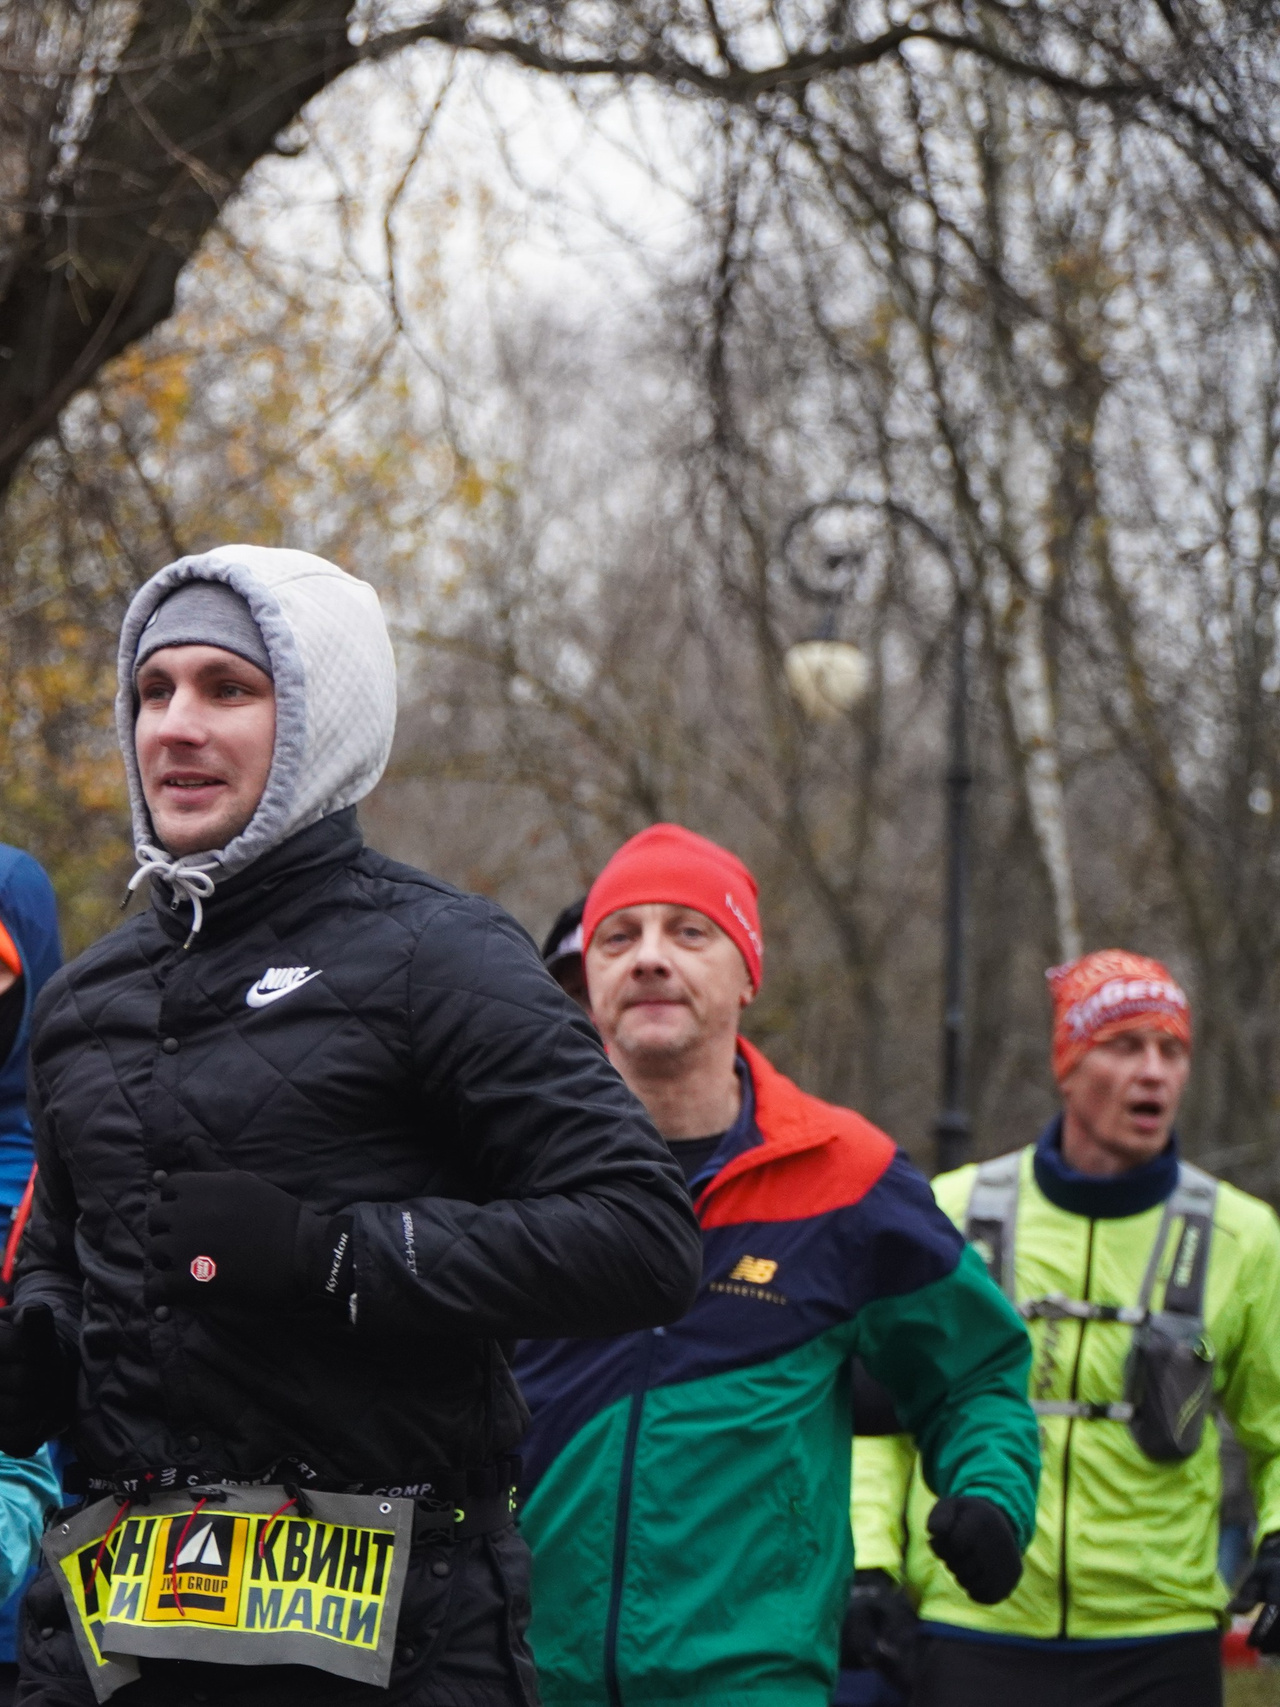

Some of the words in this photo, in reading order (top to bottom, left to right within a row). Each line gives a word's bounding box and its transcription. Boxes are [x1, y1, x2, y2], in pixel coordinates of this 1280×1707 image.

[259, 966, 310, 989] NIKE
[372, 1483, 435, 1498] COMP
[250, 1519, 395, 1596] КВИНТ
[187, 1576, 228, 1593] GROUP
[246, 1586, 380, 1645] МАДИ
